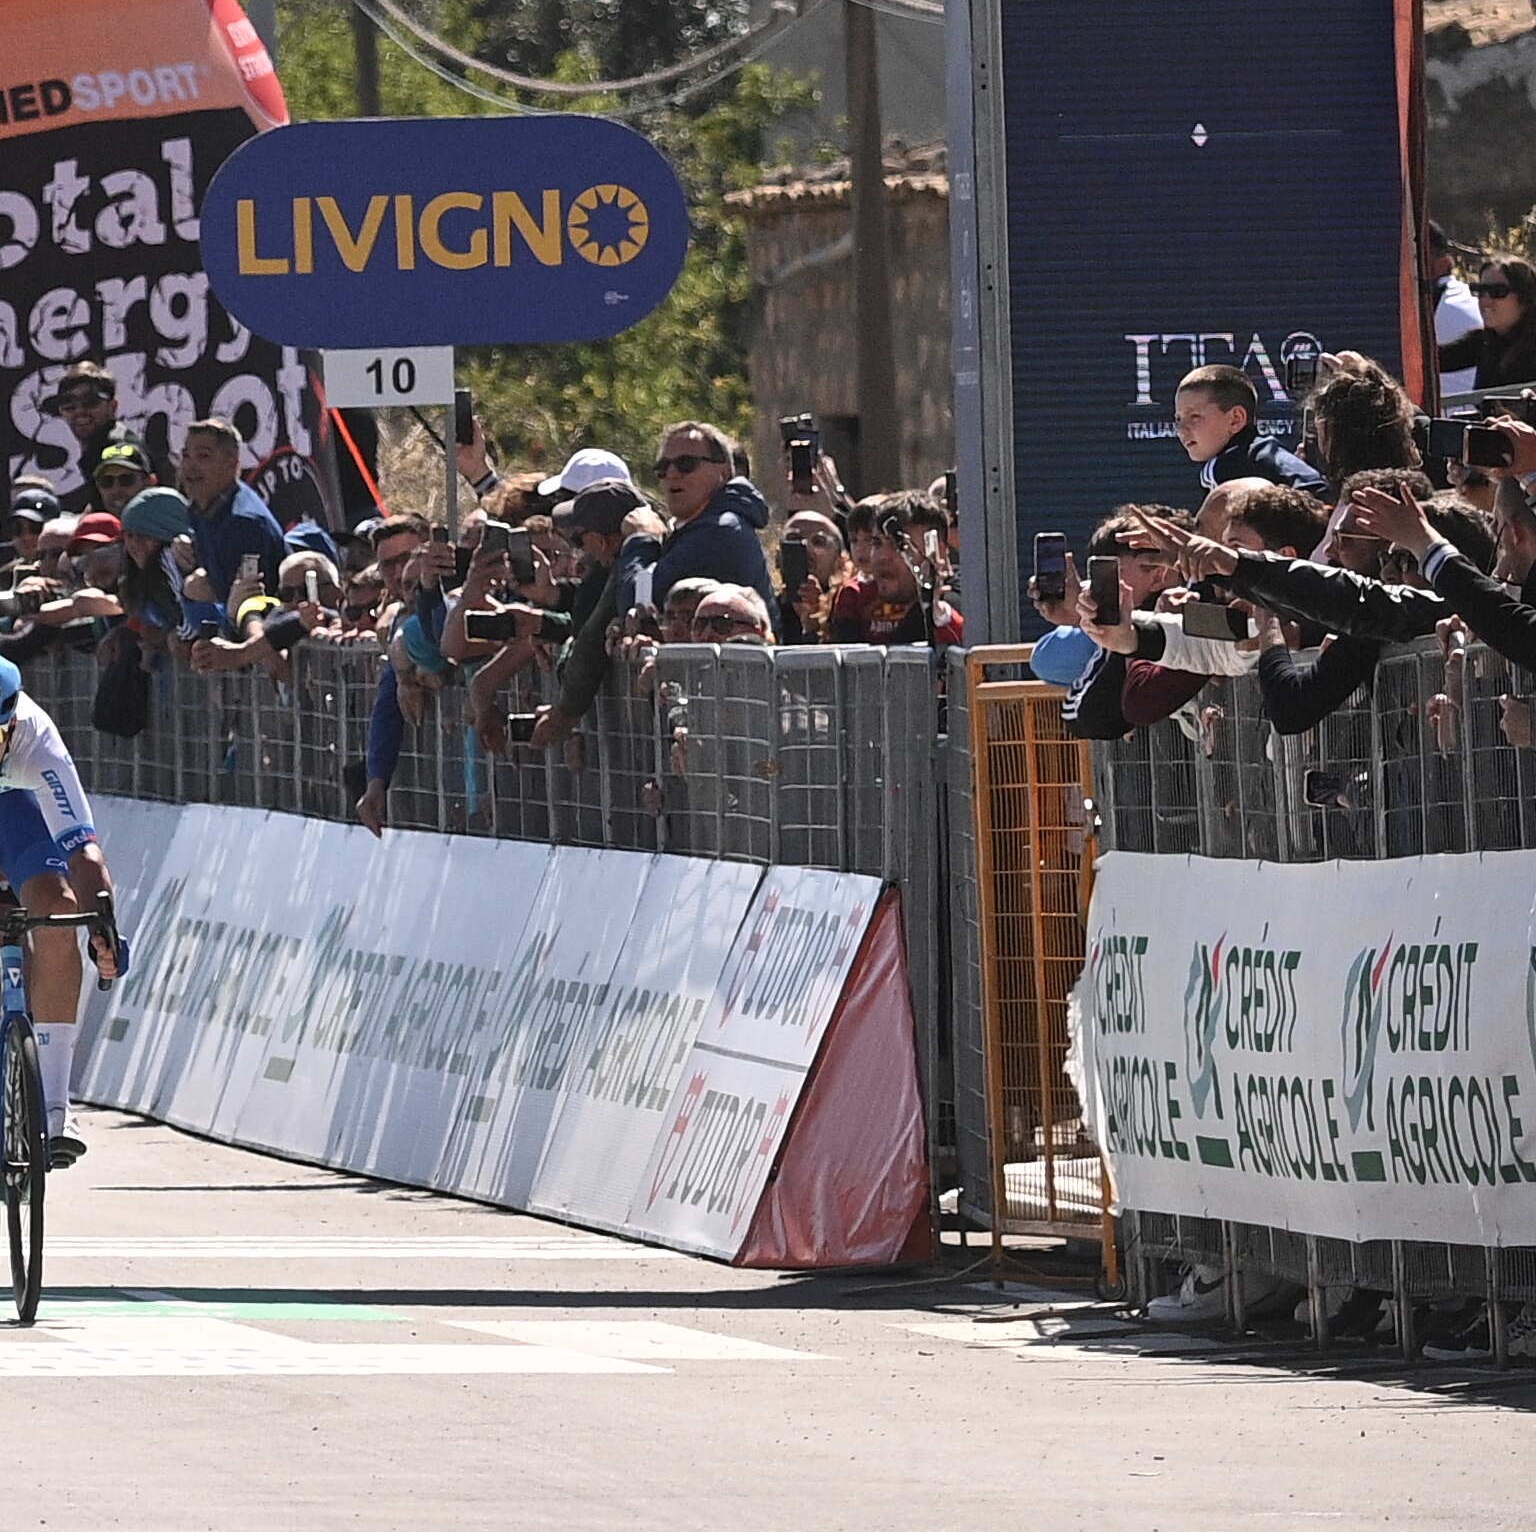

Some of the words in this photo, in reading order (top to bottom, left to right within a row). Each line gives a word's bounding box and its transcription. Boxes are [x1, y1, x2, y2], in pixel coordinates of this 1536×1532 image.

[236, 183, 650, 276] LIVIGNO
[365, 357, 416, 395] 10
[40, 769, 78, 821] GIANT
[740, 904, 842, 1028] TUDOR
[1224, 921, 1302, 1054] CRÉDIT
[1386, 915, 1480, 1054] CRÉDIT
[666, 1088, 769, 1215] TUDOR
[1232, 1071, 1350, 1184] AGRICOLE
[1386, 1074, 1536, 1187] AGRICOLE
